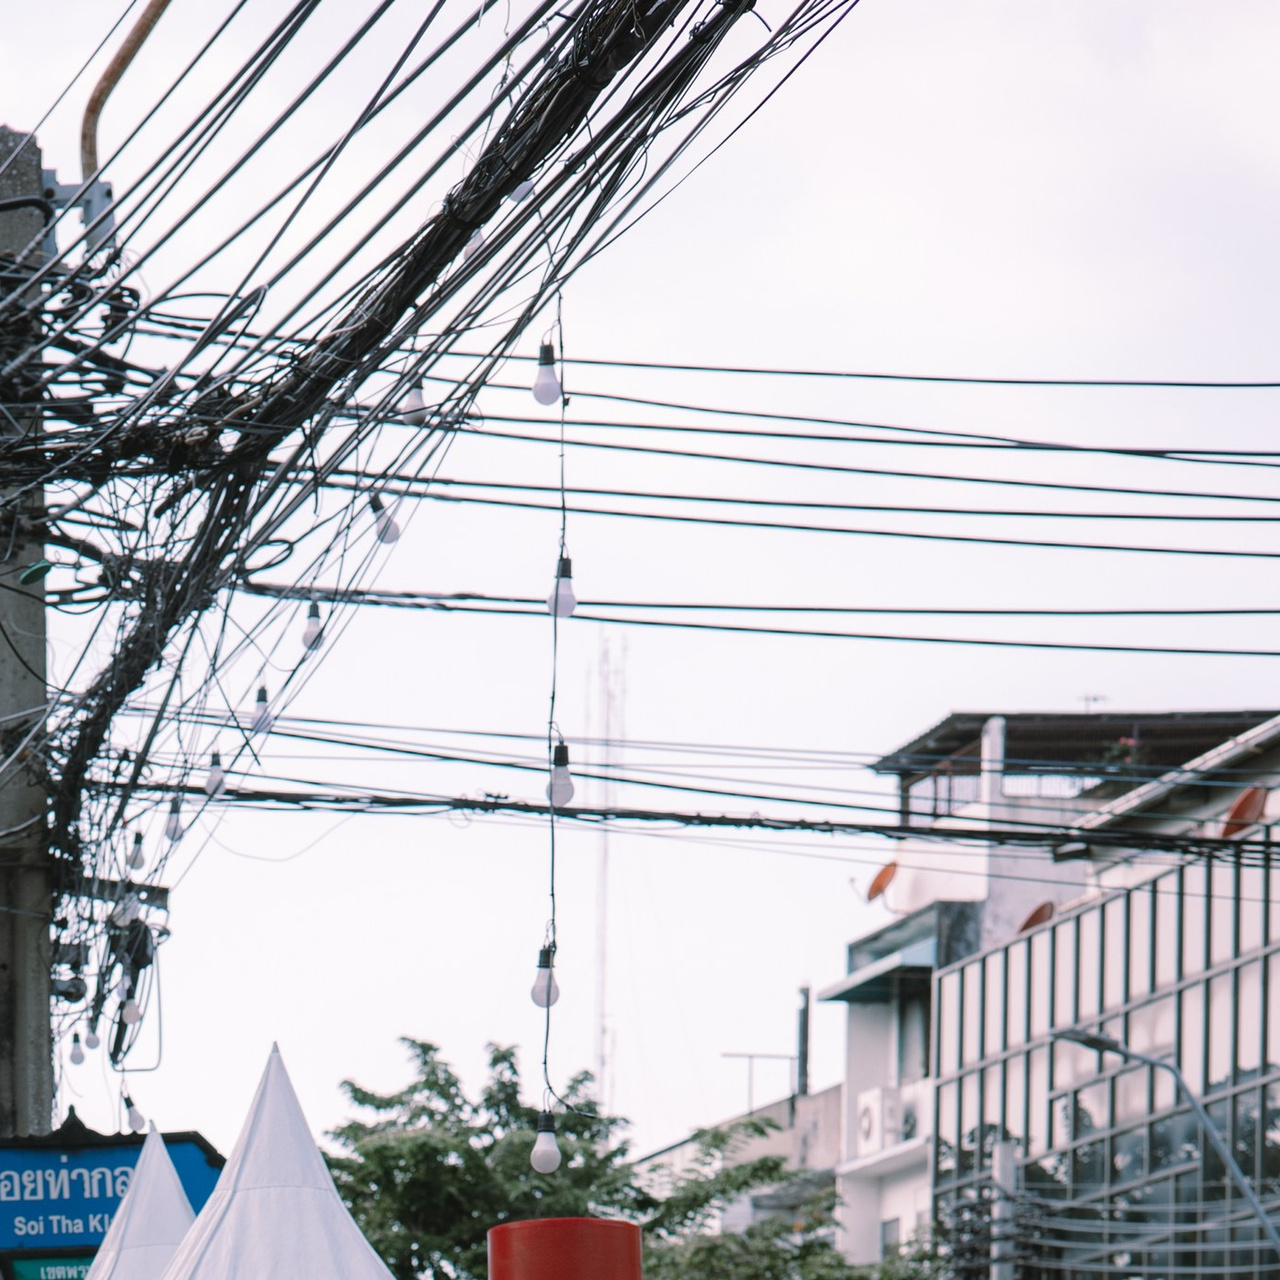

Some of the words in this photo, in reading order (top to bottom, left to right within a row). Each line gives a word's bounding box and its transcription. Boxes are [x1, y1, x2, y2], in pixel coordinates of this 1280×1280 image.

[14, 1216, 44, 1236] Soi
[49, 1215, 84, 1235] Tha
[89, 1213, 116, 1233] Kl
